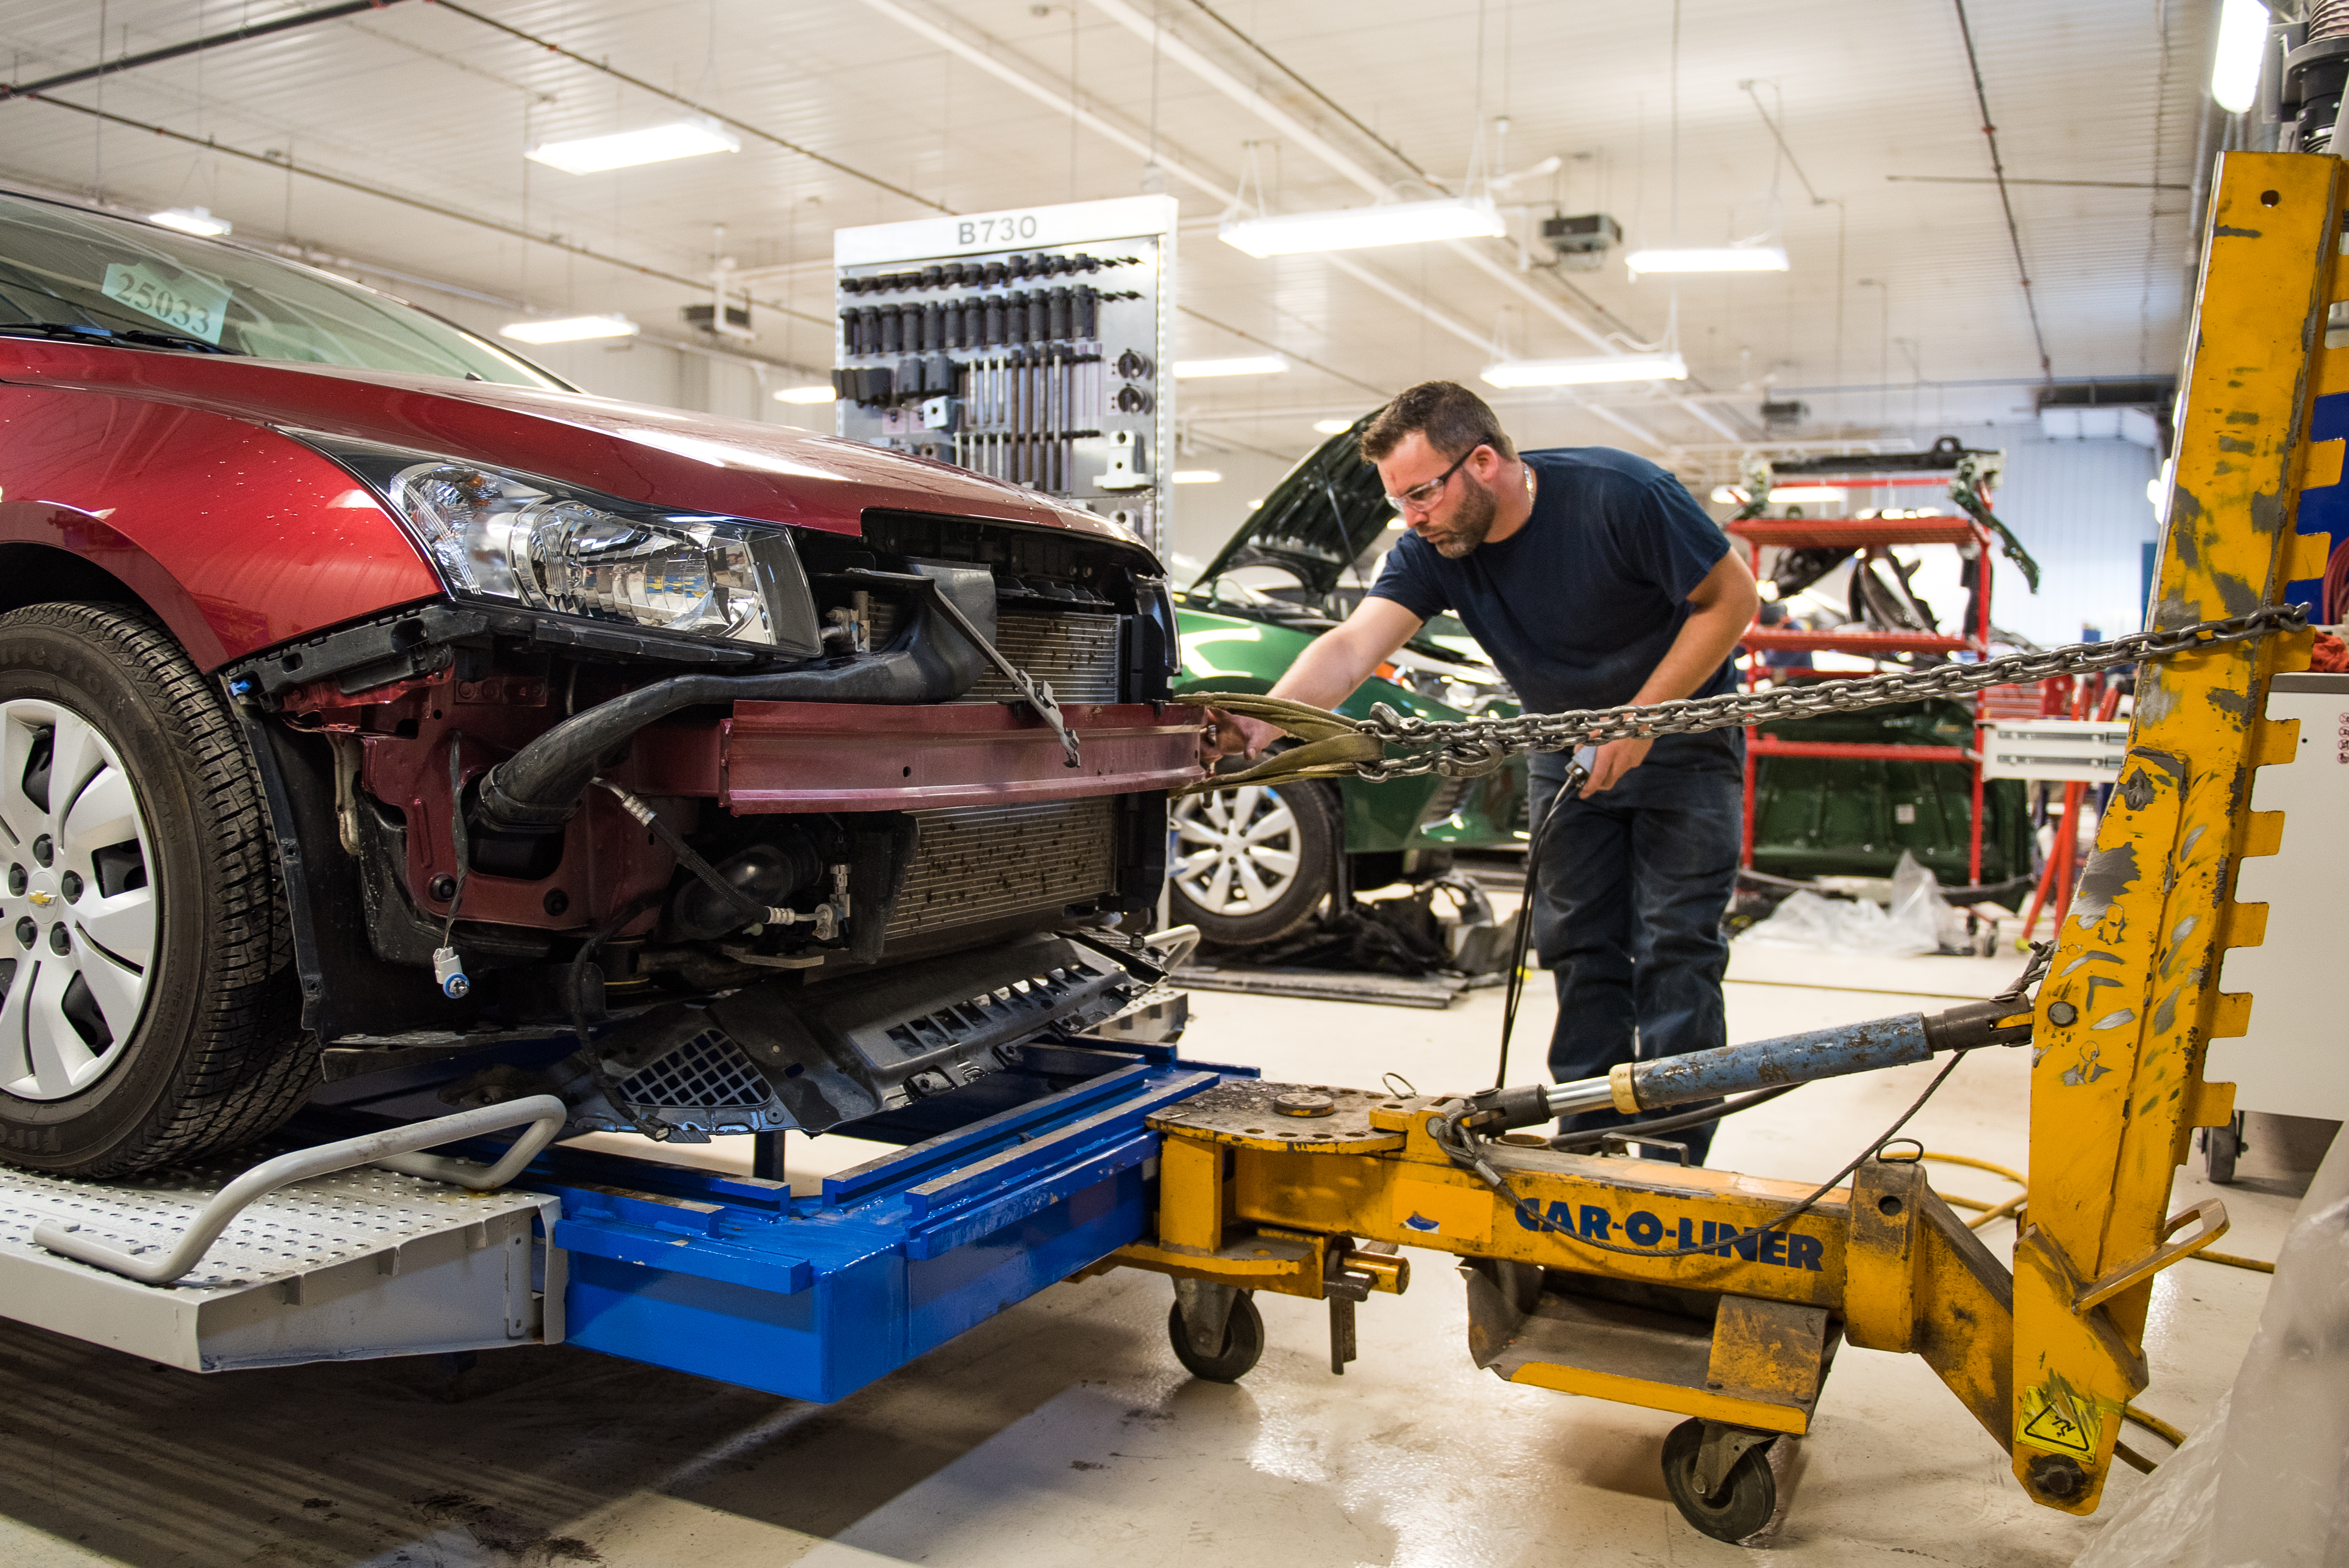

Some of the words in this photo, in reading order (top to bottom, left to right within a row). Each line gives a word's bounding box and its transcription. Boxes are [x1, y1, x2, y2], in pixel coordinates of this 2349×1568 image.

[959, 215, 1036, 245] B730
[115, 273, 209, 335] 25033
[1515, 1197, 1824, 1272] CAR-O-LINER
